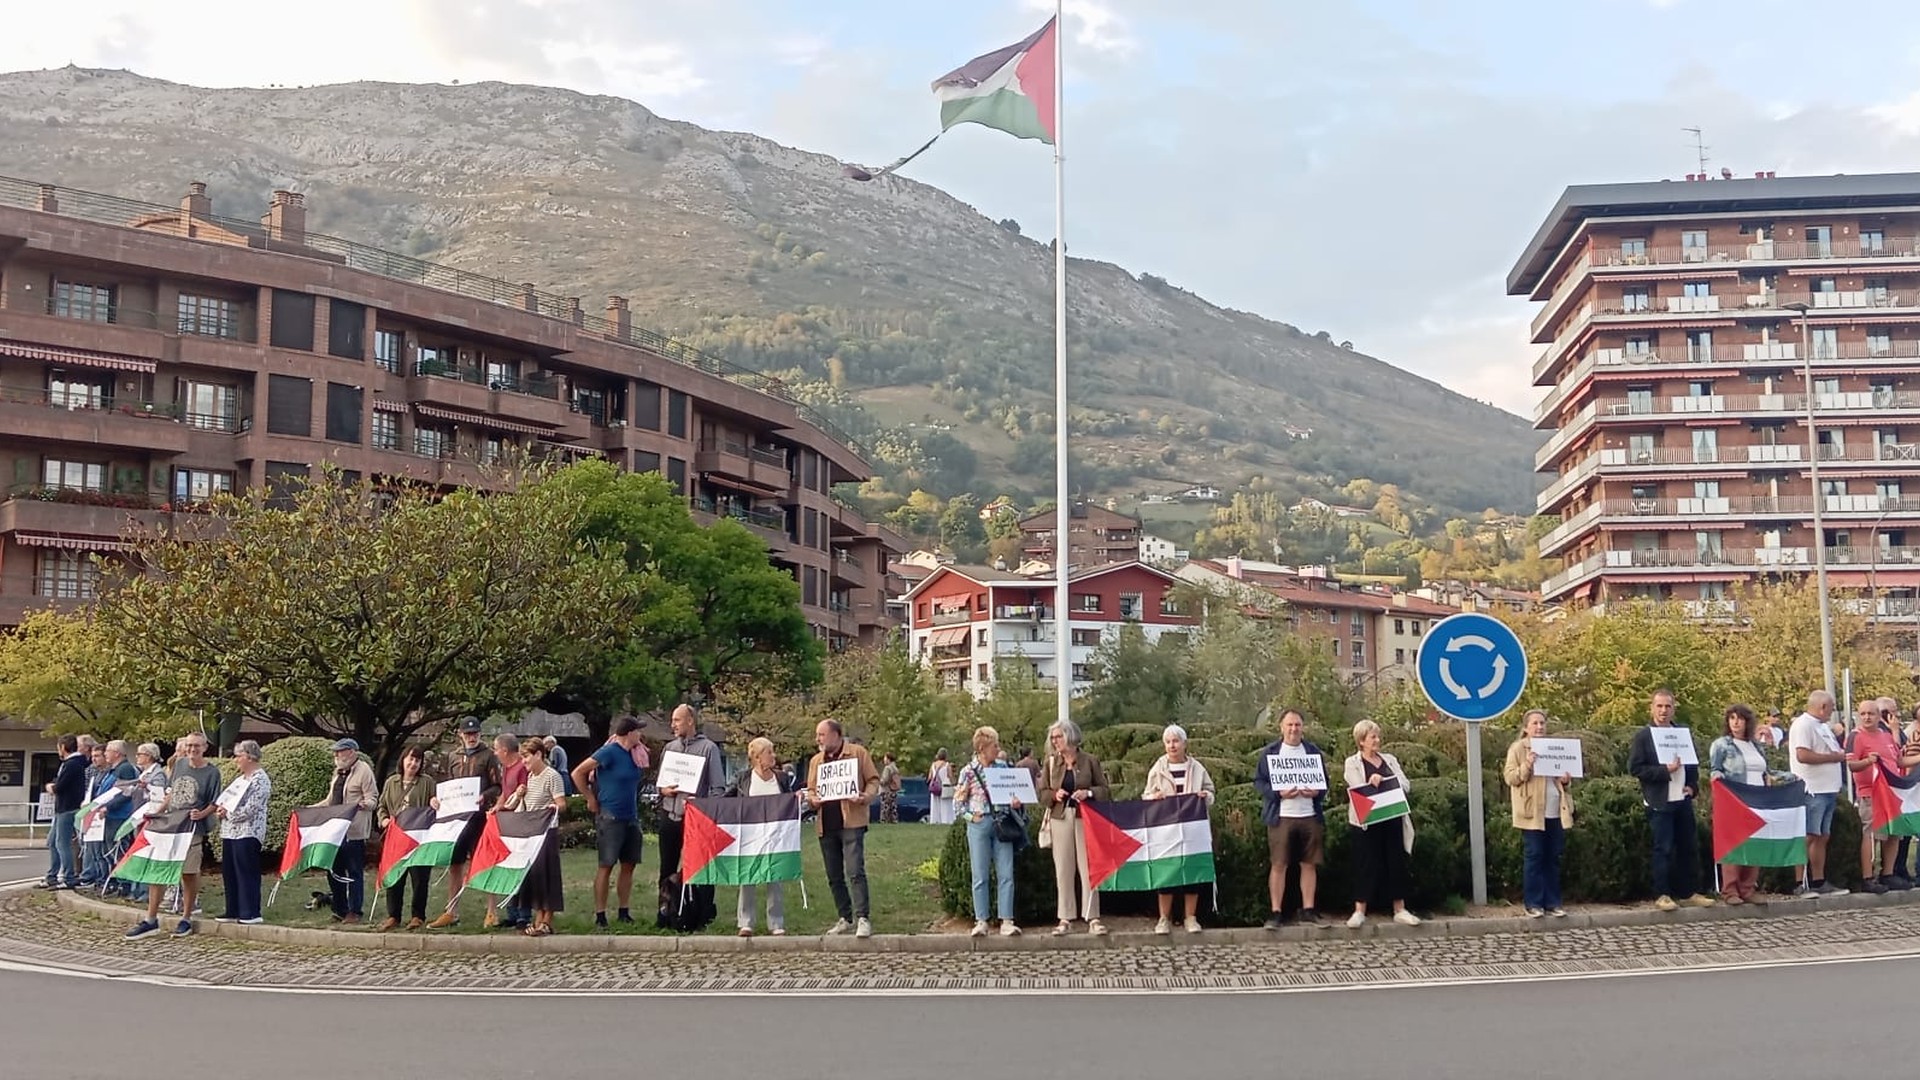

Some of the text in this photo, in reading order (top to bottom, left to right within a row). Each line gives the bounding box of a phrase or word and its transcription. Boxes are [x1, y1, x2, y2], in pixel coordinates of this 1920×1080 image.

[1271, 757, 1319, 770] PALESTINARI
[820, 762, 852, 780] ISRAELI
[1270, 772, 1324, 785] ELKARTASUNA
